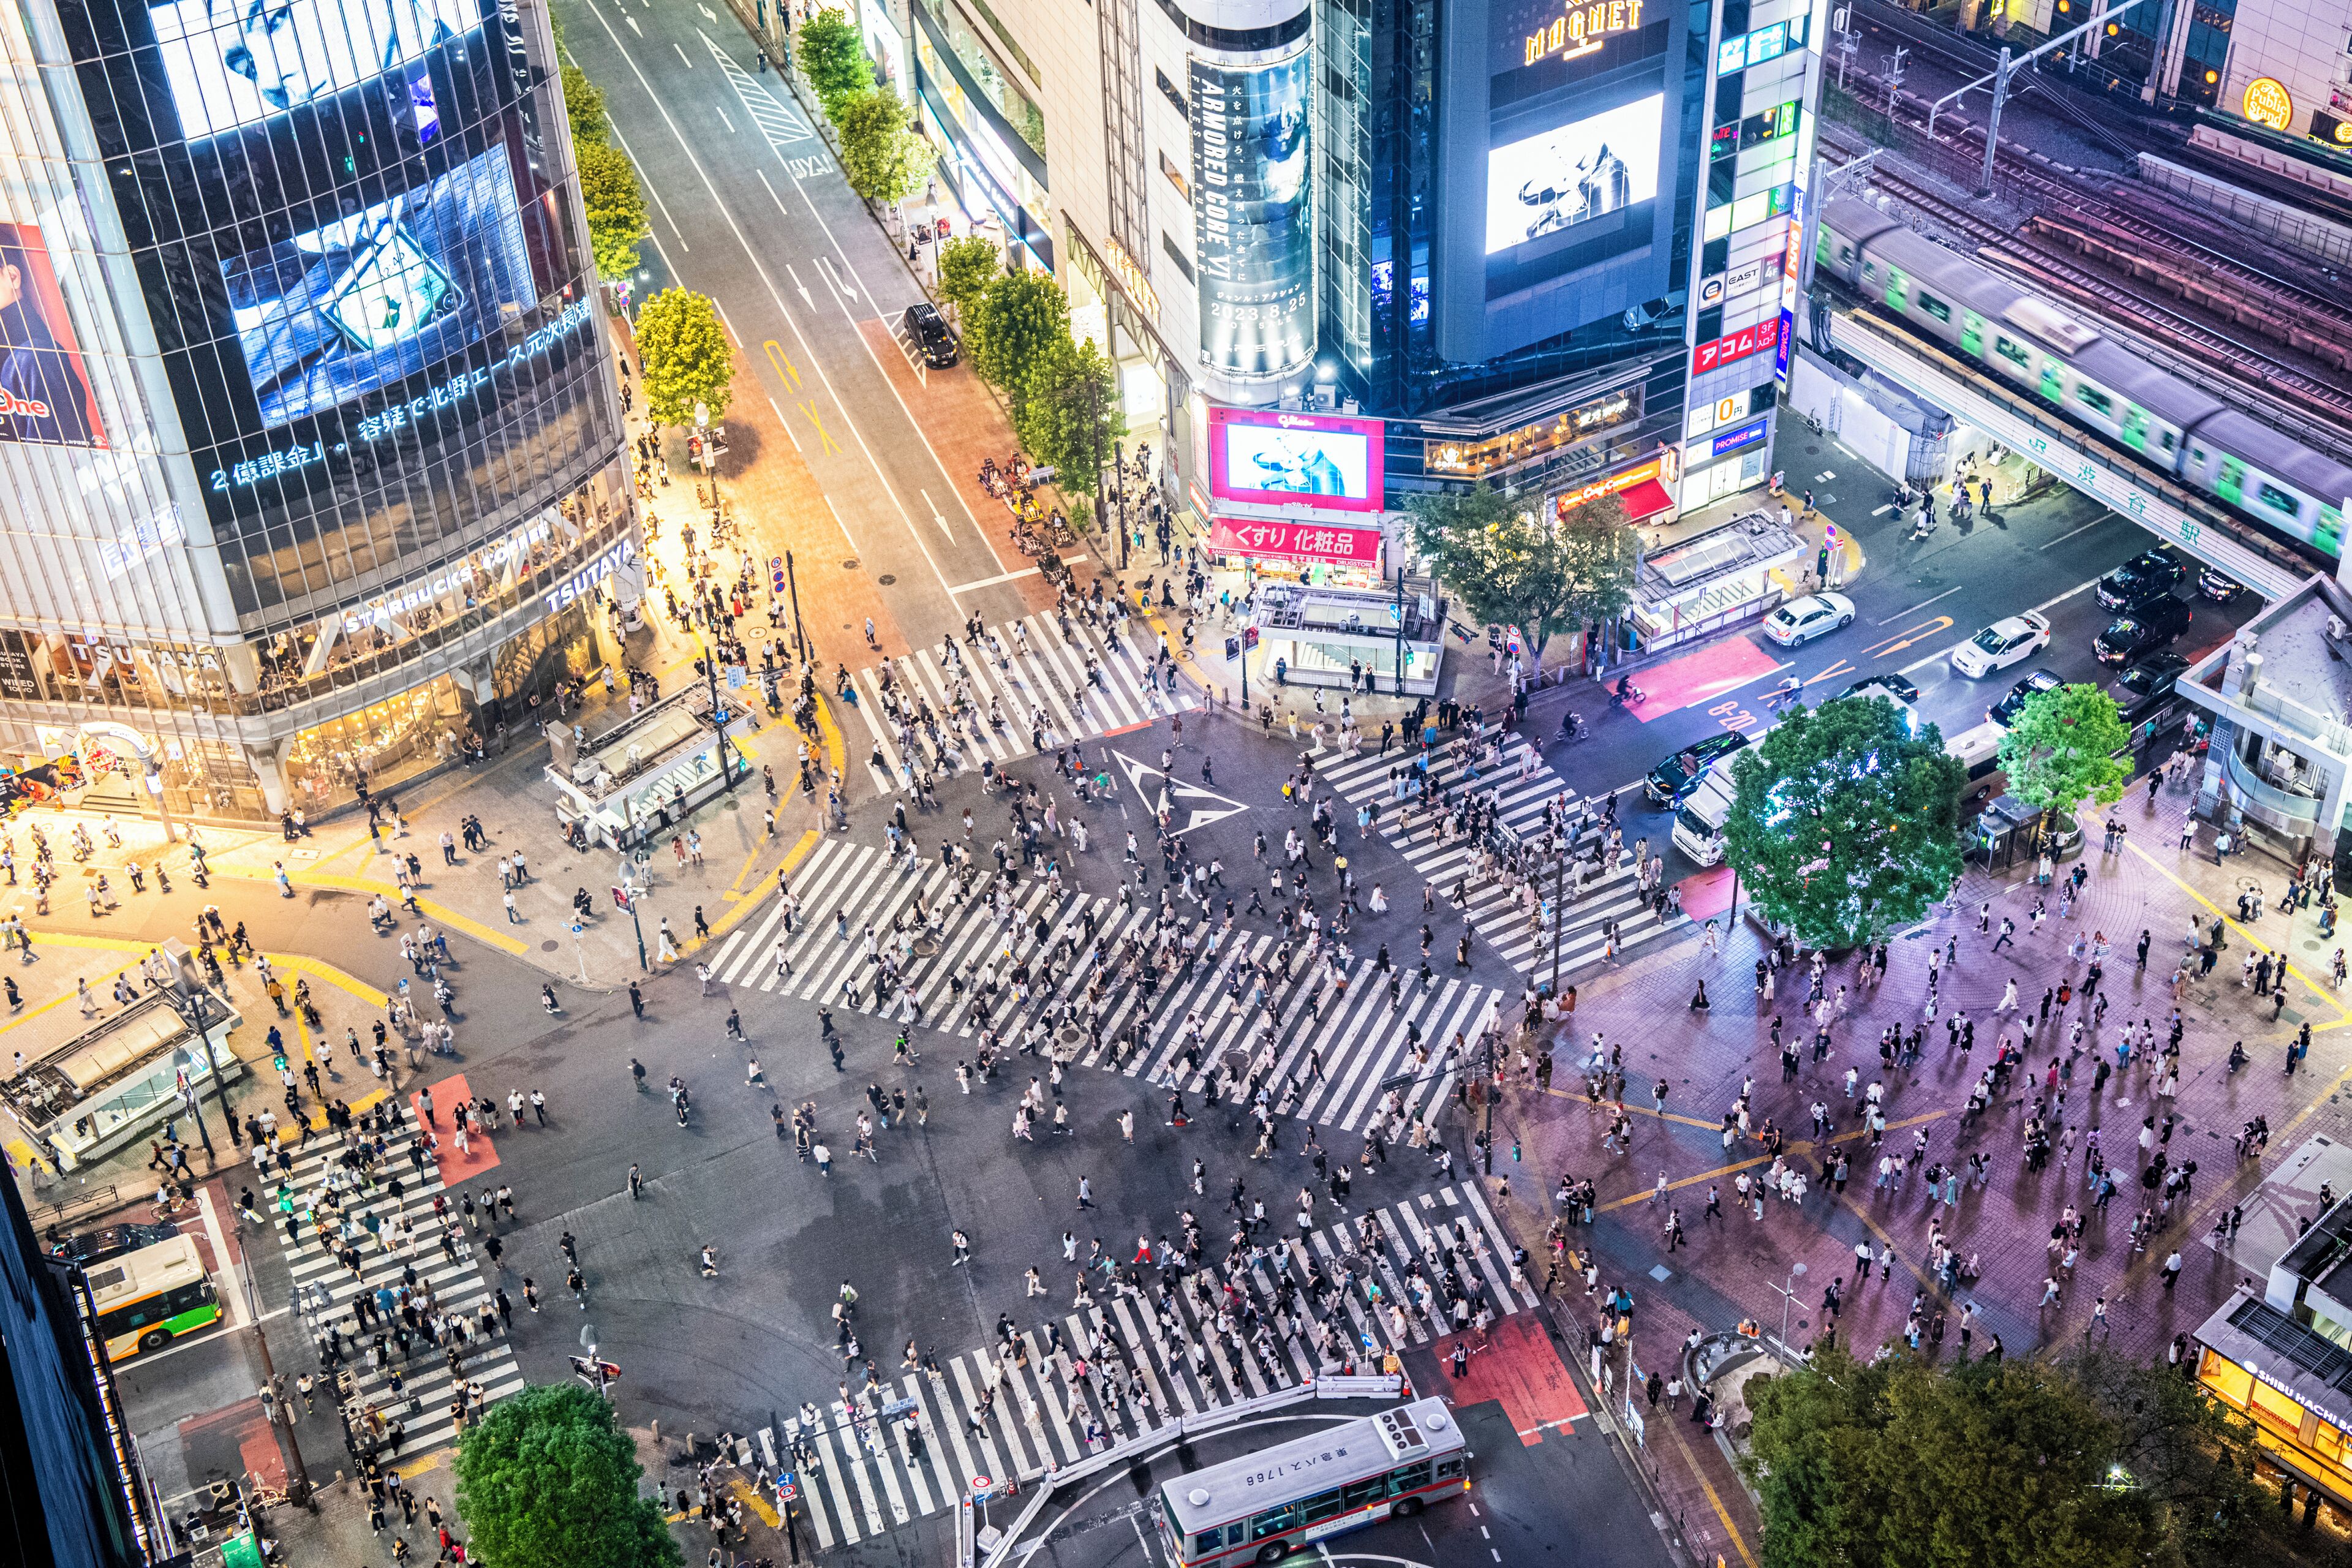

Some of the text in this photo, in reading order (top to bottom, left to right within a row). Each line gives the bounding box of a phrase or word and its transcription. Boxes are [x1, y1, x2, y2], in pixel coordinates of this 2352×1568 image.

[1525, 1, 1643, 66] MAGNET
[2251, 88, 2287, 116] Public
[2260, 83, 2280, 99] The
[2248, 100, 2283, 126] Stand
[1191, 74, 1207, 275] FIRES OF RUBICON
[1202, 78, 1231, 281] ARMORED CORE VI
[1728, 268, 1759, 285] EAST
[1765, 266, 1778, 278] 4F
[1211, 291, 1306, 321] 2023.8.25
[1231, 322, 1248, 330] ON
[1760, 322, 1774, 334] 3F
[1779, 319, 1790, 362] PROMISE
[1702, 334, 1753, 366] アコム
[1756, 338, 1770, 349] 入口
[1716, 431, 1748, 451] PROMISE
[2029, 437, 2047, 454] JR
[1434, 459, 1468, 470] COFFEE
[2077, 461, 2200, 546] 渋谷駅
[1236, 525, 1353, 556] くすり 化粧品
[344, 519, 550, 634] STARBUCKS COFFEE
[545, 538, 635, 614] TSUTAYA
[1336, 560, 1373, 568] DRUGSTORE
[72, 643, 220, 673] TSUTAYA
[1708, 700, 1758, 731] 8-20
[2257, 1370, 2294, 1397] SHIBU
[2295, 1392, 2337, 1424] HACHI
